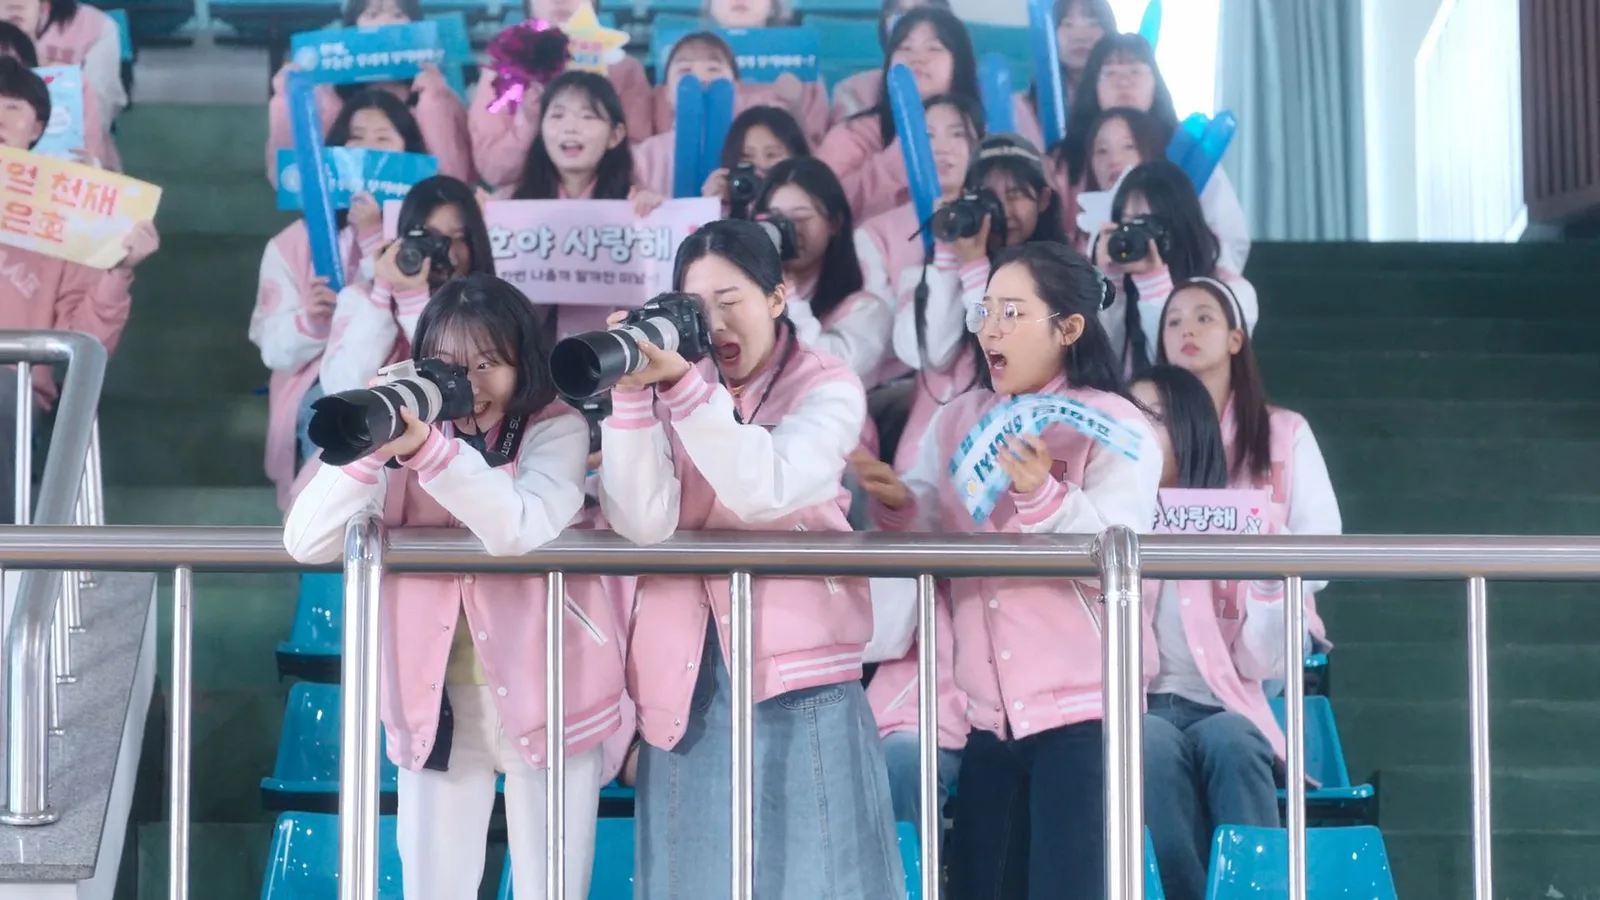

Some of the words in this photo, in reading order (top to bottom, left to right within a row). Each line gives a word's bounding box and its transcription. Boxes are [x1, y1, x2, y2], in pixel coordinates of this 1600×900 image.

[50, 172, 118, 216] 천재
[1, 201, 66, 243] 은호
[487, 225, 556, 260] 호야
[562, 224, 673, 263] 사랑해
[501, 431, 515, 458] DIGIT
[1163, 504, 1238, 532] 사랑해
